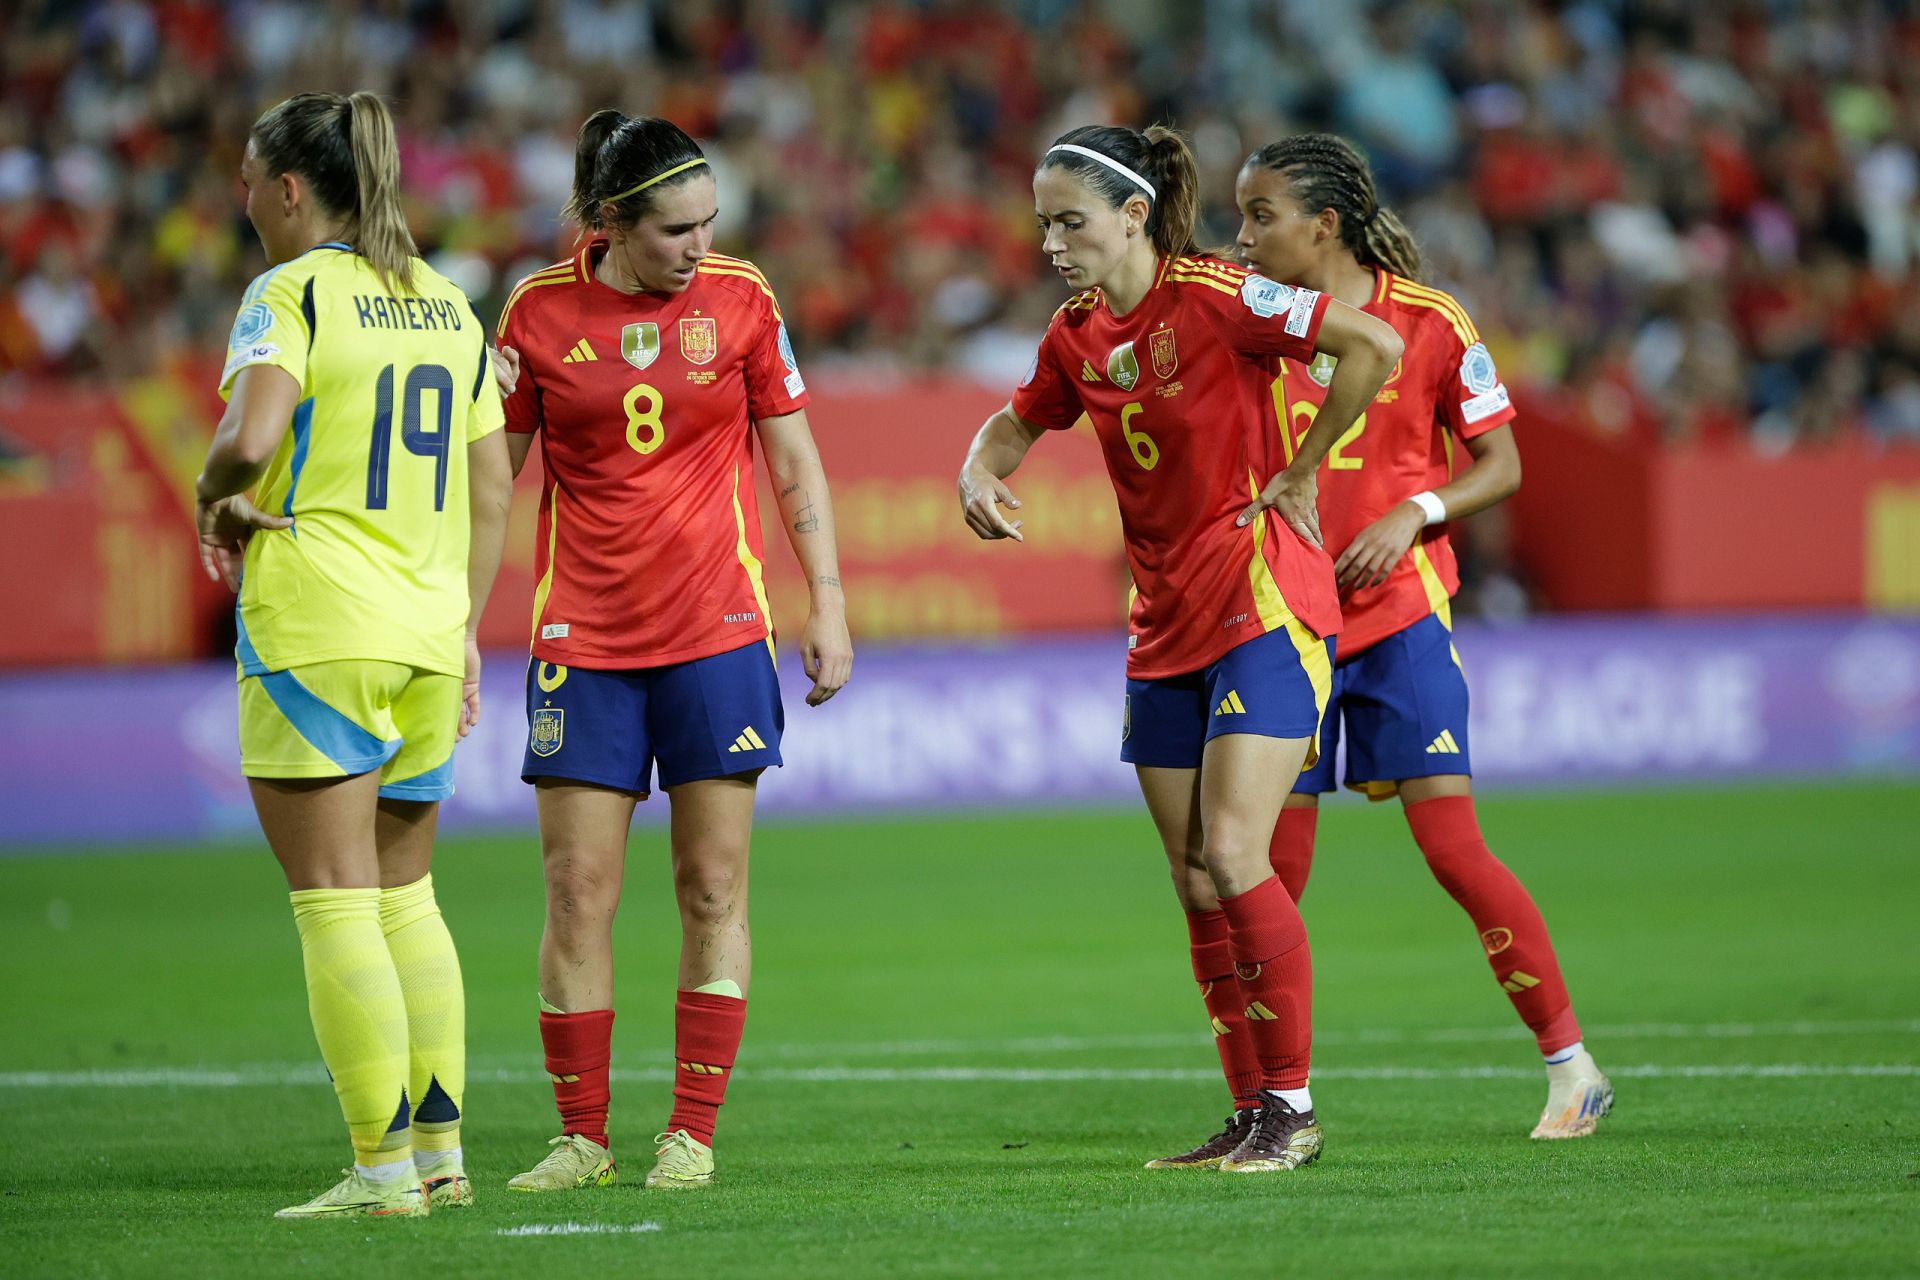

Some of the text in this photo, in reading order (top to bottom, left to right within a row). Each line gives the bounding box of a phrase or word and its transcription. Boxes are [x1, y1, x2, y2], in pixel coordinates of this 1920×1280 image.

[353, 295, 462, 331] KANERYD
[1116, 372, 1131, 380] FIFA
[365, 363, 453, 512] 19
[623, 383, 665, 455] 8
[1120, 402, 1160, 471] 6
